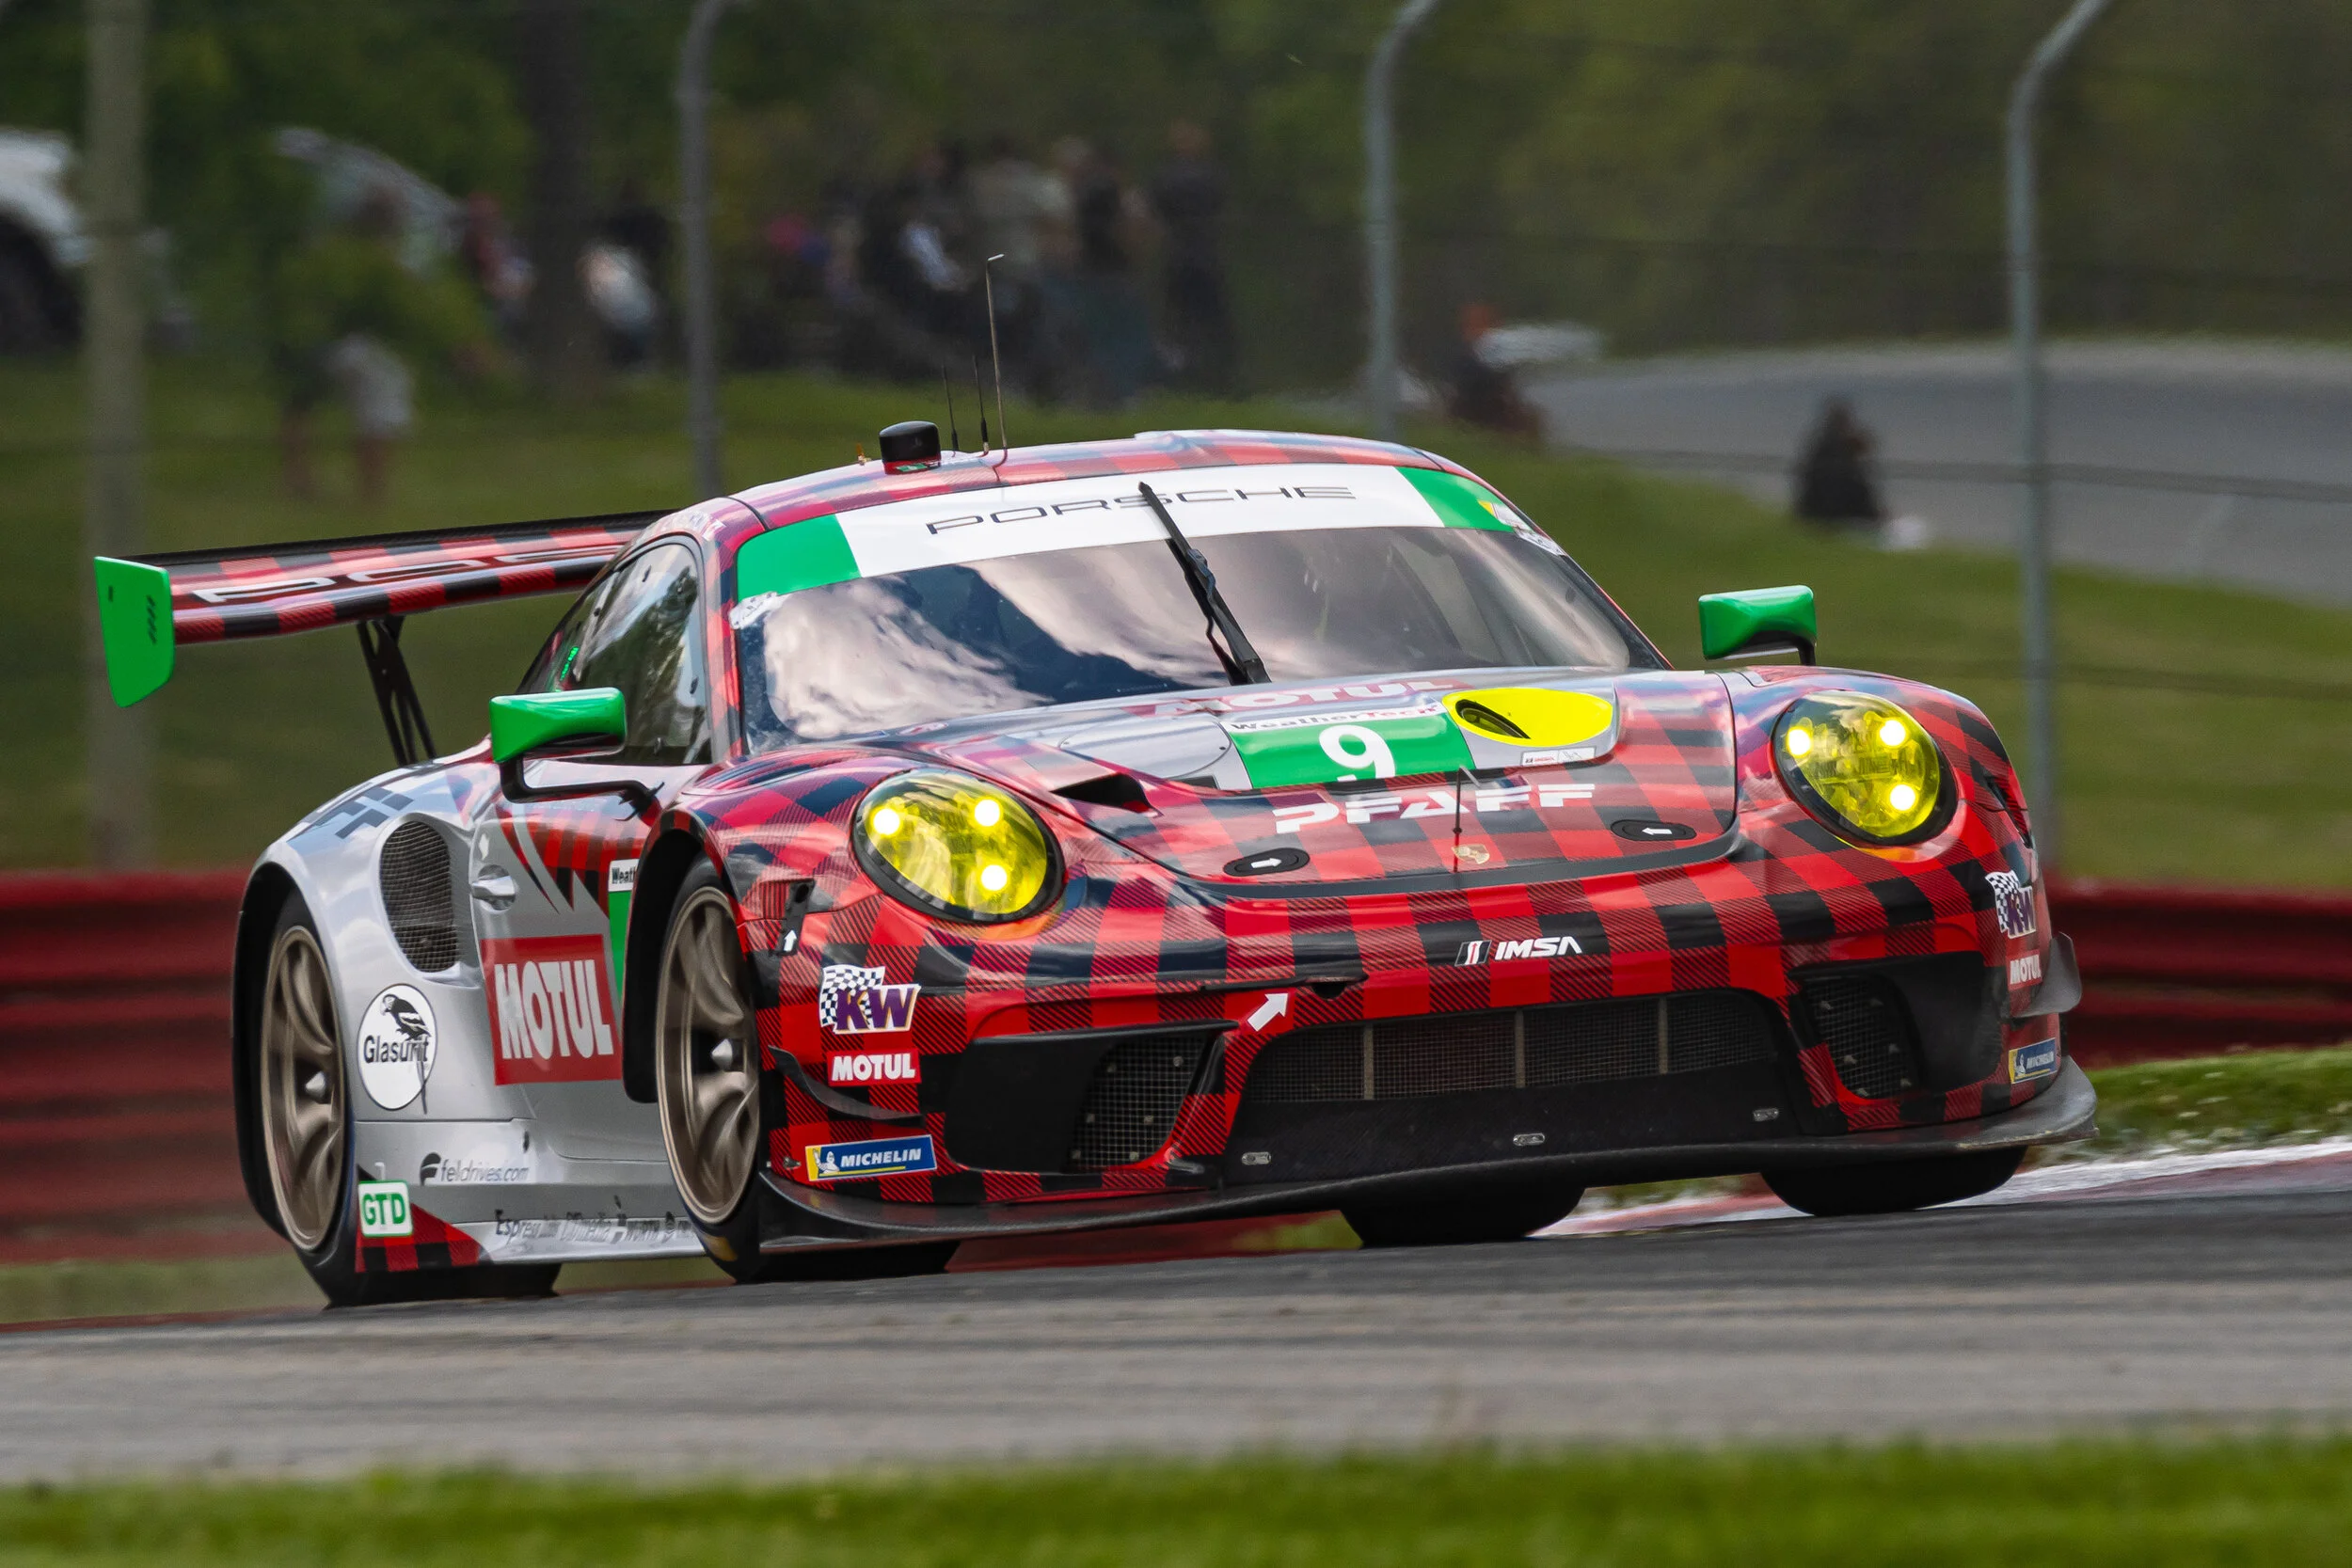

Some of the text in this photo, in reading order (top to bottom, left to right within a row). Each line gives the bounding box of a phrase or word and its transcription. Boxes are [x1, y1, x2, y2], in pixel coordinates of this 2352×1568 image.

[926, 485, 1357, 535] PORSCHE
[1156, 680, 1454, 716] MOTUL
[1231, 705, 1438, 731] WeatherTech
[1319, 724, 1396, 782] 9
[1273, 783, 1596, 834] PFAFF
[2005, 889, 2035, 936] KW
[1494, 936, 1582, 960] IMSA
[2010, 954, 2042, 985] MOTUL
[494, 958, 613, 1059] MOTUL
[836, 988, 914, 1031] KW
[832, 1053, 915, 1082] MOTUL
[840, 1148, 922, 1167] MICHELIN
[362, 1190, 405, 1227] GTD
